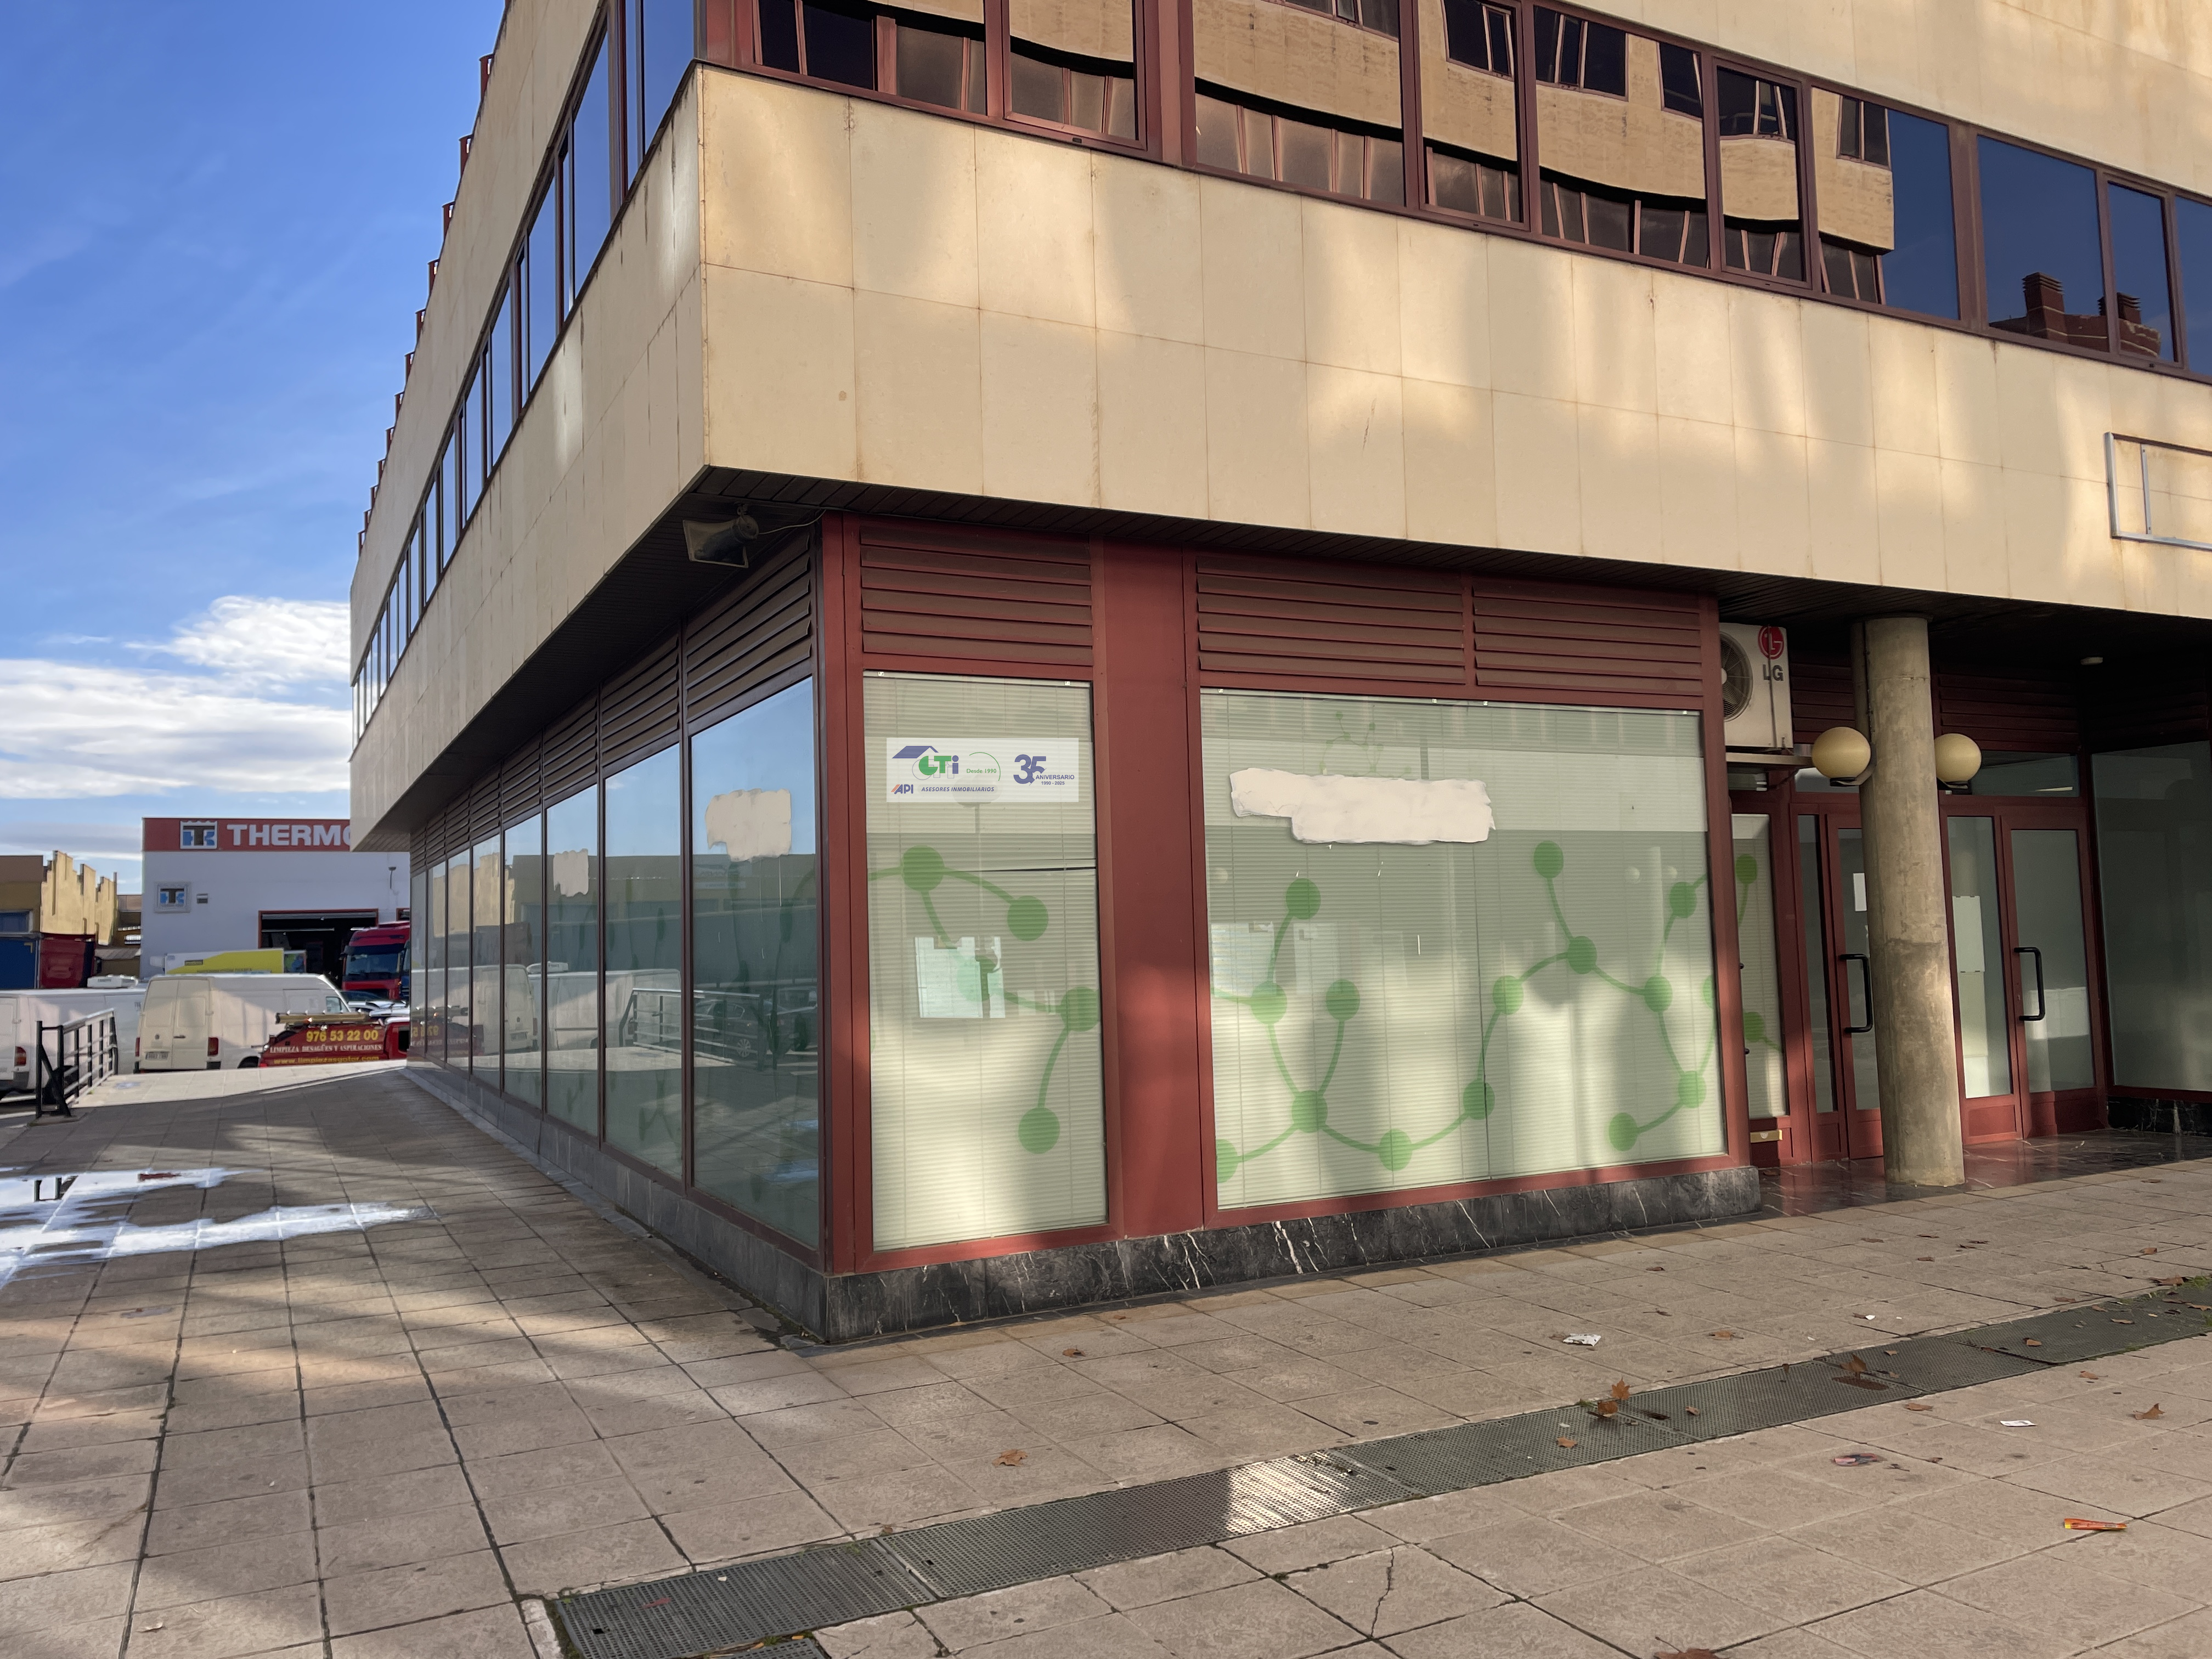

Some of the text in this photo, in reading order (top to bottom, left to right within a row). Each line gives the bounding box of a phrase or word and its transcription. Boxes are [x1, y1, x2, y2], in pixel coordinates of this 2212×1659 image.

[1763, 664, 1784, 681] LG
[306, 1029, 379, 1041] 976 53 22 00
[269, 1045, 299, 1053] LIMPIEZA
